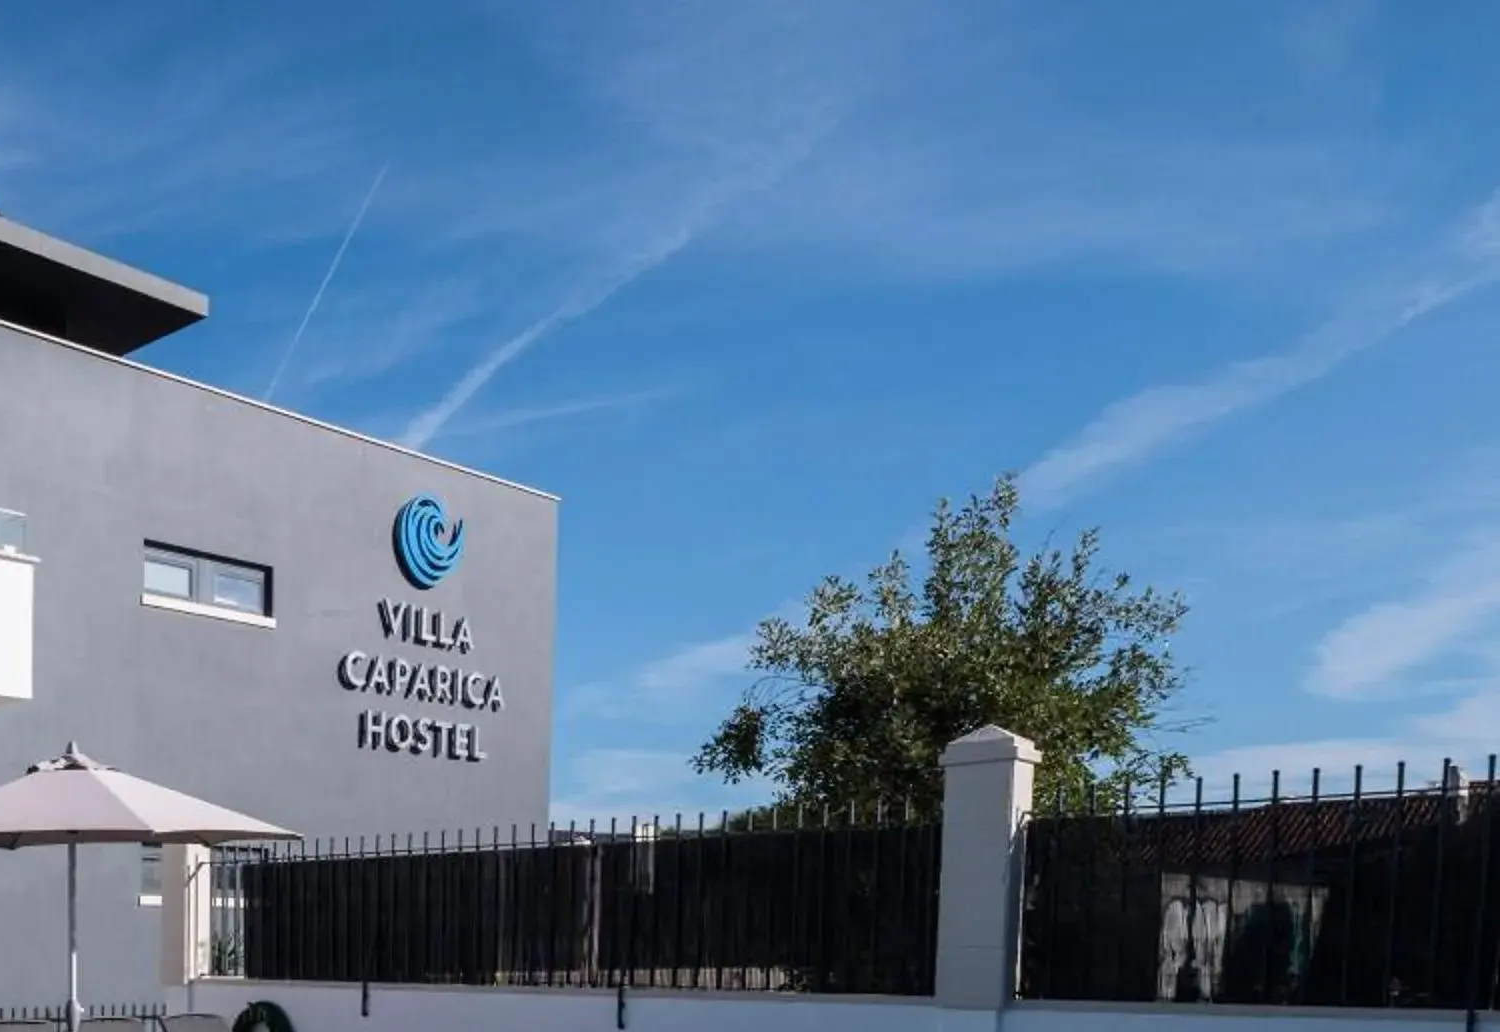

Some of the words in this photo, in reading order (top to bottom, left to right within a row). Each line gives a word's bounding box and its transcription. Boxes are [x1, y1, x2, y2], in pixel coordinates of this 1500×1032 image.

[377, 597, 475, 653] VILLA
[338, 650, 505, 712] CAPARICA
[358, 709, 488, 762] HOSTEL
